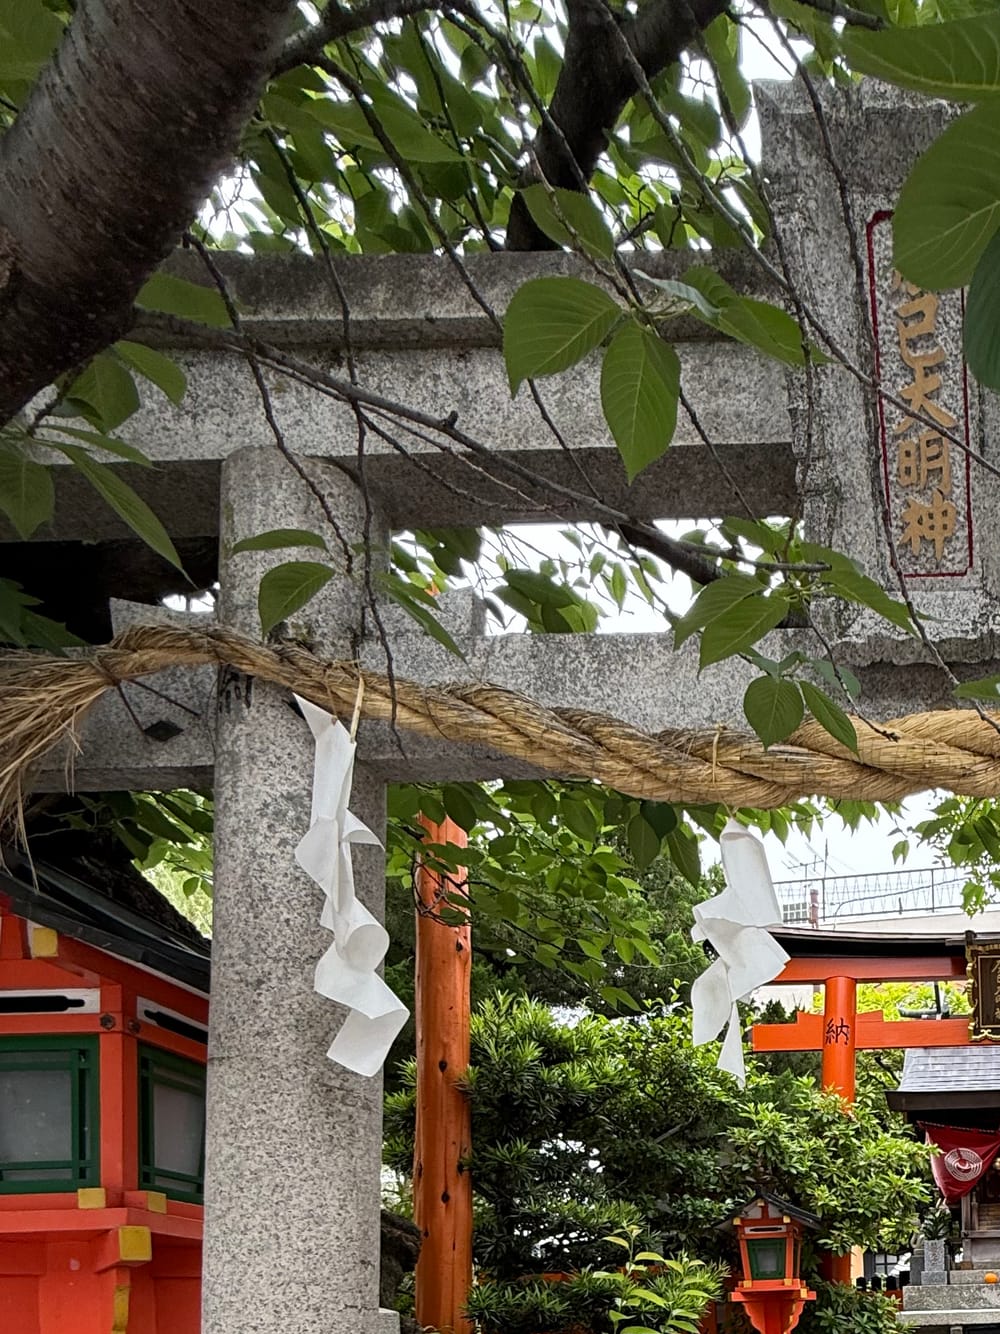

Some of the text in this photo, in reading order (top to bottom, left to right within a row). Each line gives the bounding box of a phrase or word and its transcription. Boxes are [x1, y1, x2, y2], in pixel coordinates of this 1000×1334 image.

[892, 268, 958, 561] 巳大明神
[826, 1017, 850, 1045] 納
